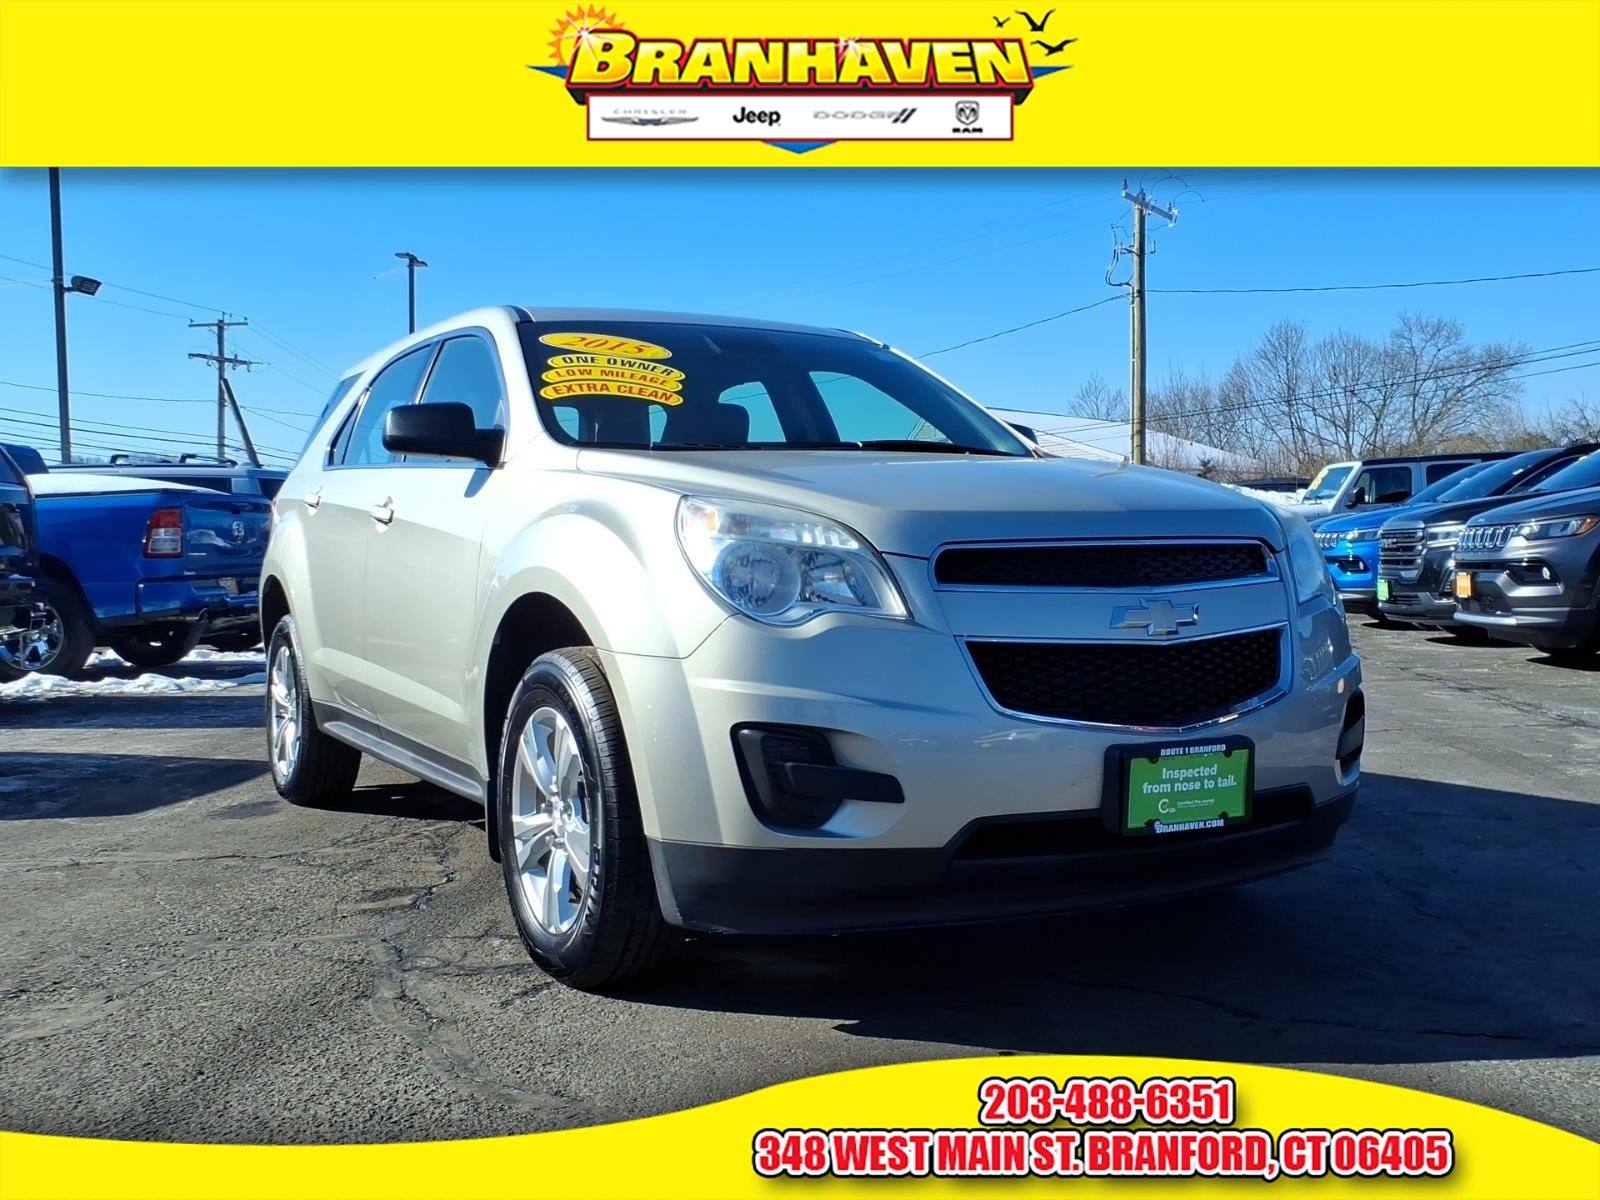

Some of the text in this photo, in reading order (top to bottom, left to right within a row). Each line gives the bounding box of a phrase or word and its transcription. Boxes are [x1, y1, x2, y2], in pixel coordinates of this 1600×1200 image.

[560, 337, 650, 353] 2015
[607, 358, 673, 376] OWNER
[556, 369, 672, 386] LOW MILEAGE
[552, 383, 673, 401] EXTRA CLEAN
[1161, 747, 1184, 756] ROUTE
[1190, 744, 1226, 753] BRANFORD
[1162, 764, 1217, 780] Inspected
[1143, 775, 1237, 793] from nose to tail.
[1154, 819, 1224, 833] BRANHAVEN.COM
